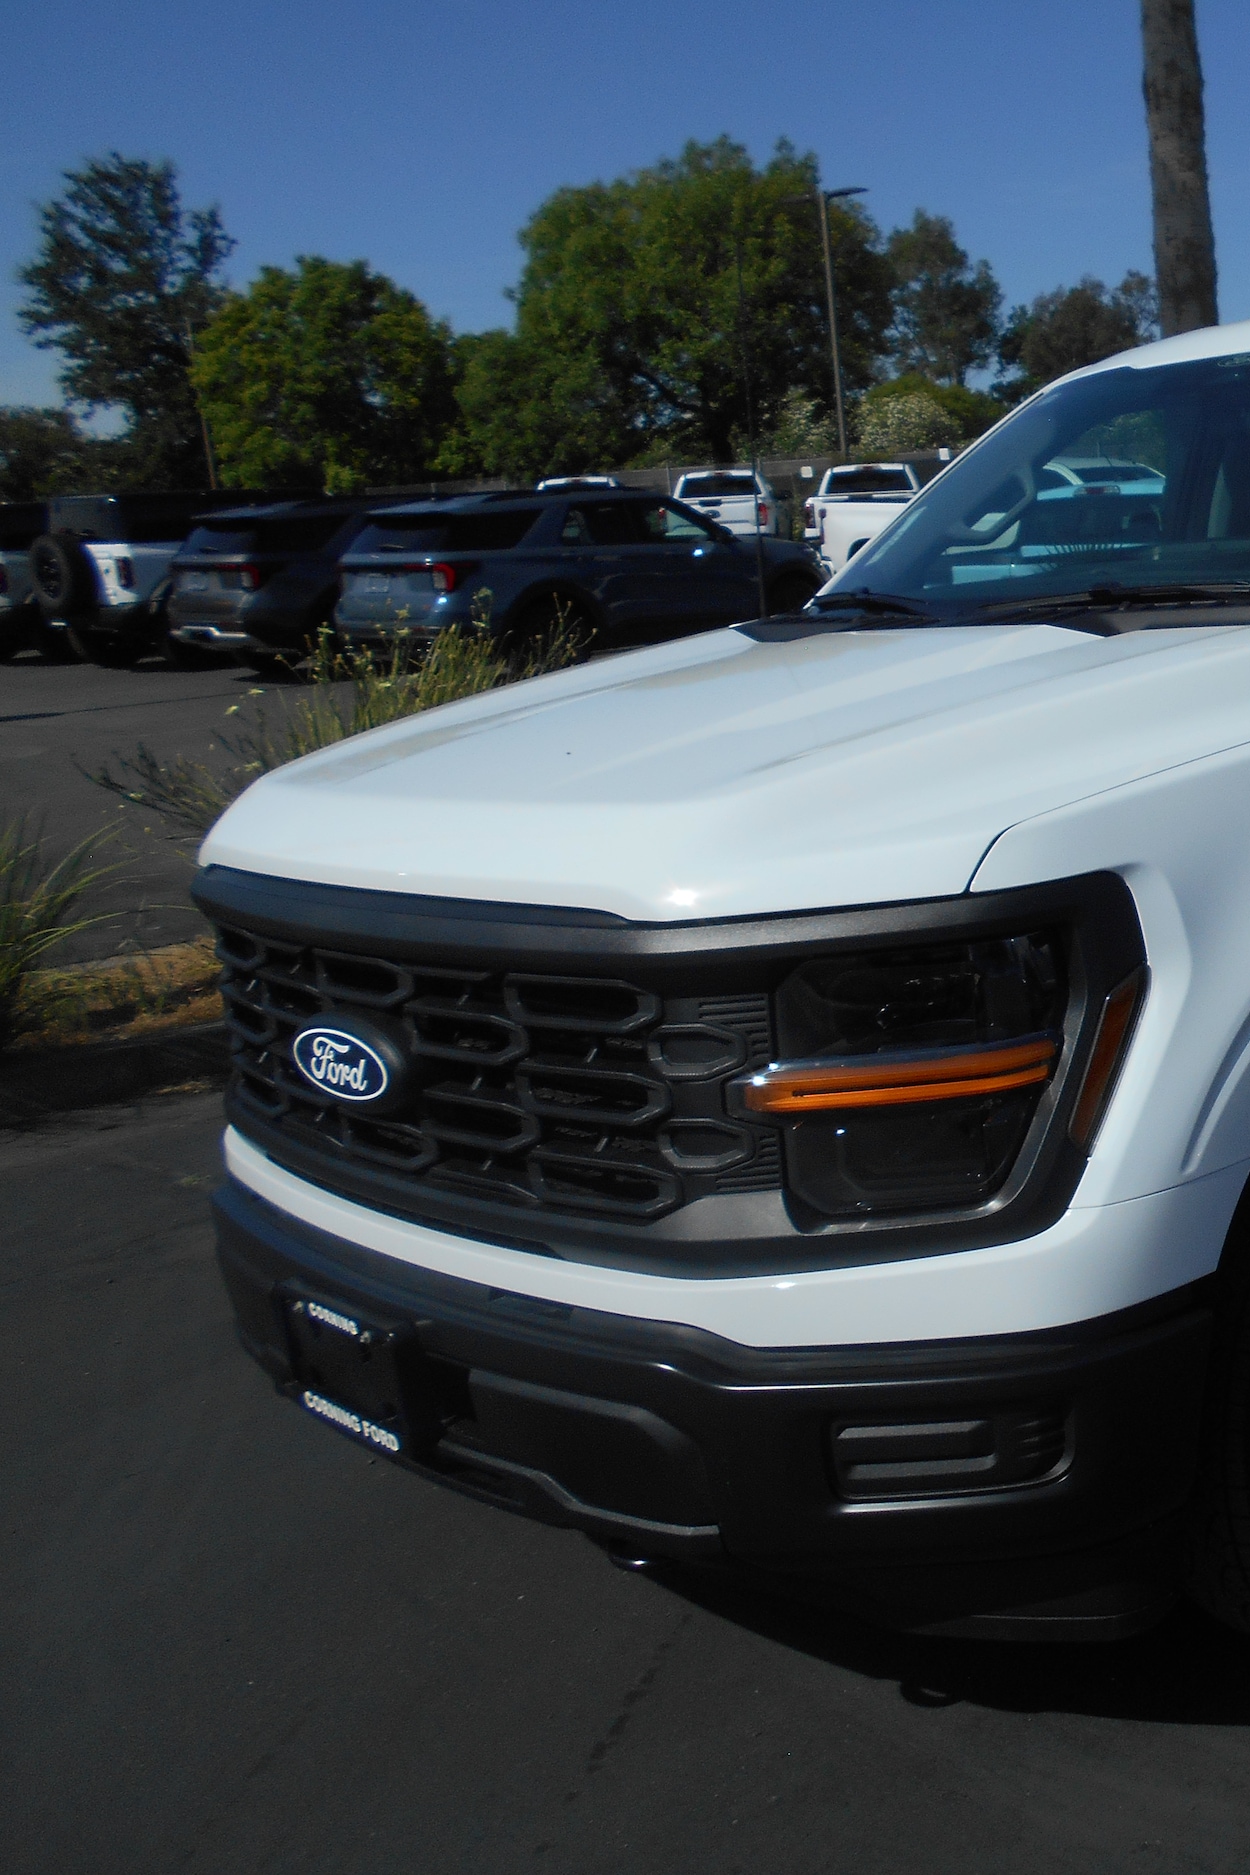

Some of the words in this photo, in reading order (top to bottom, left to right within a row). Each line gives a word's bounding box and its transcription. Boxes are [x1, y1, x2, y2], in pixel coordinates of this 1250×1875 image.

[310, 1036, 368, 1092] Ford
[304, 1391, 361, 1432] CORNING
[362, 1420, 399, 1452] FORD
